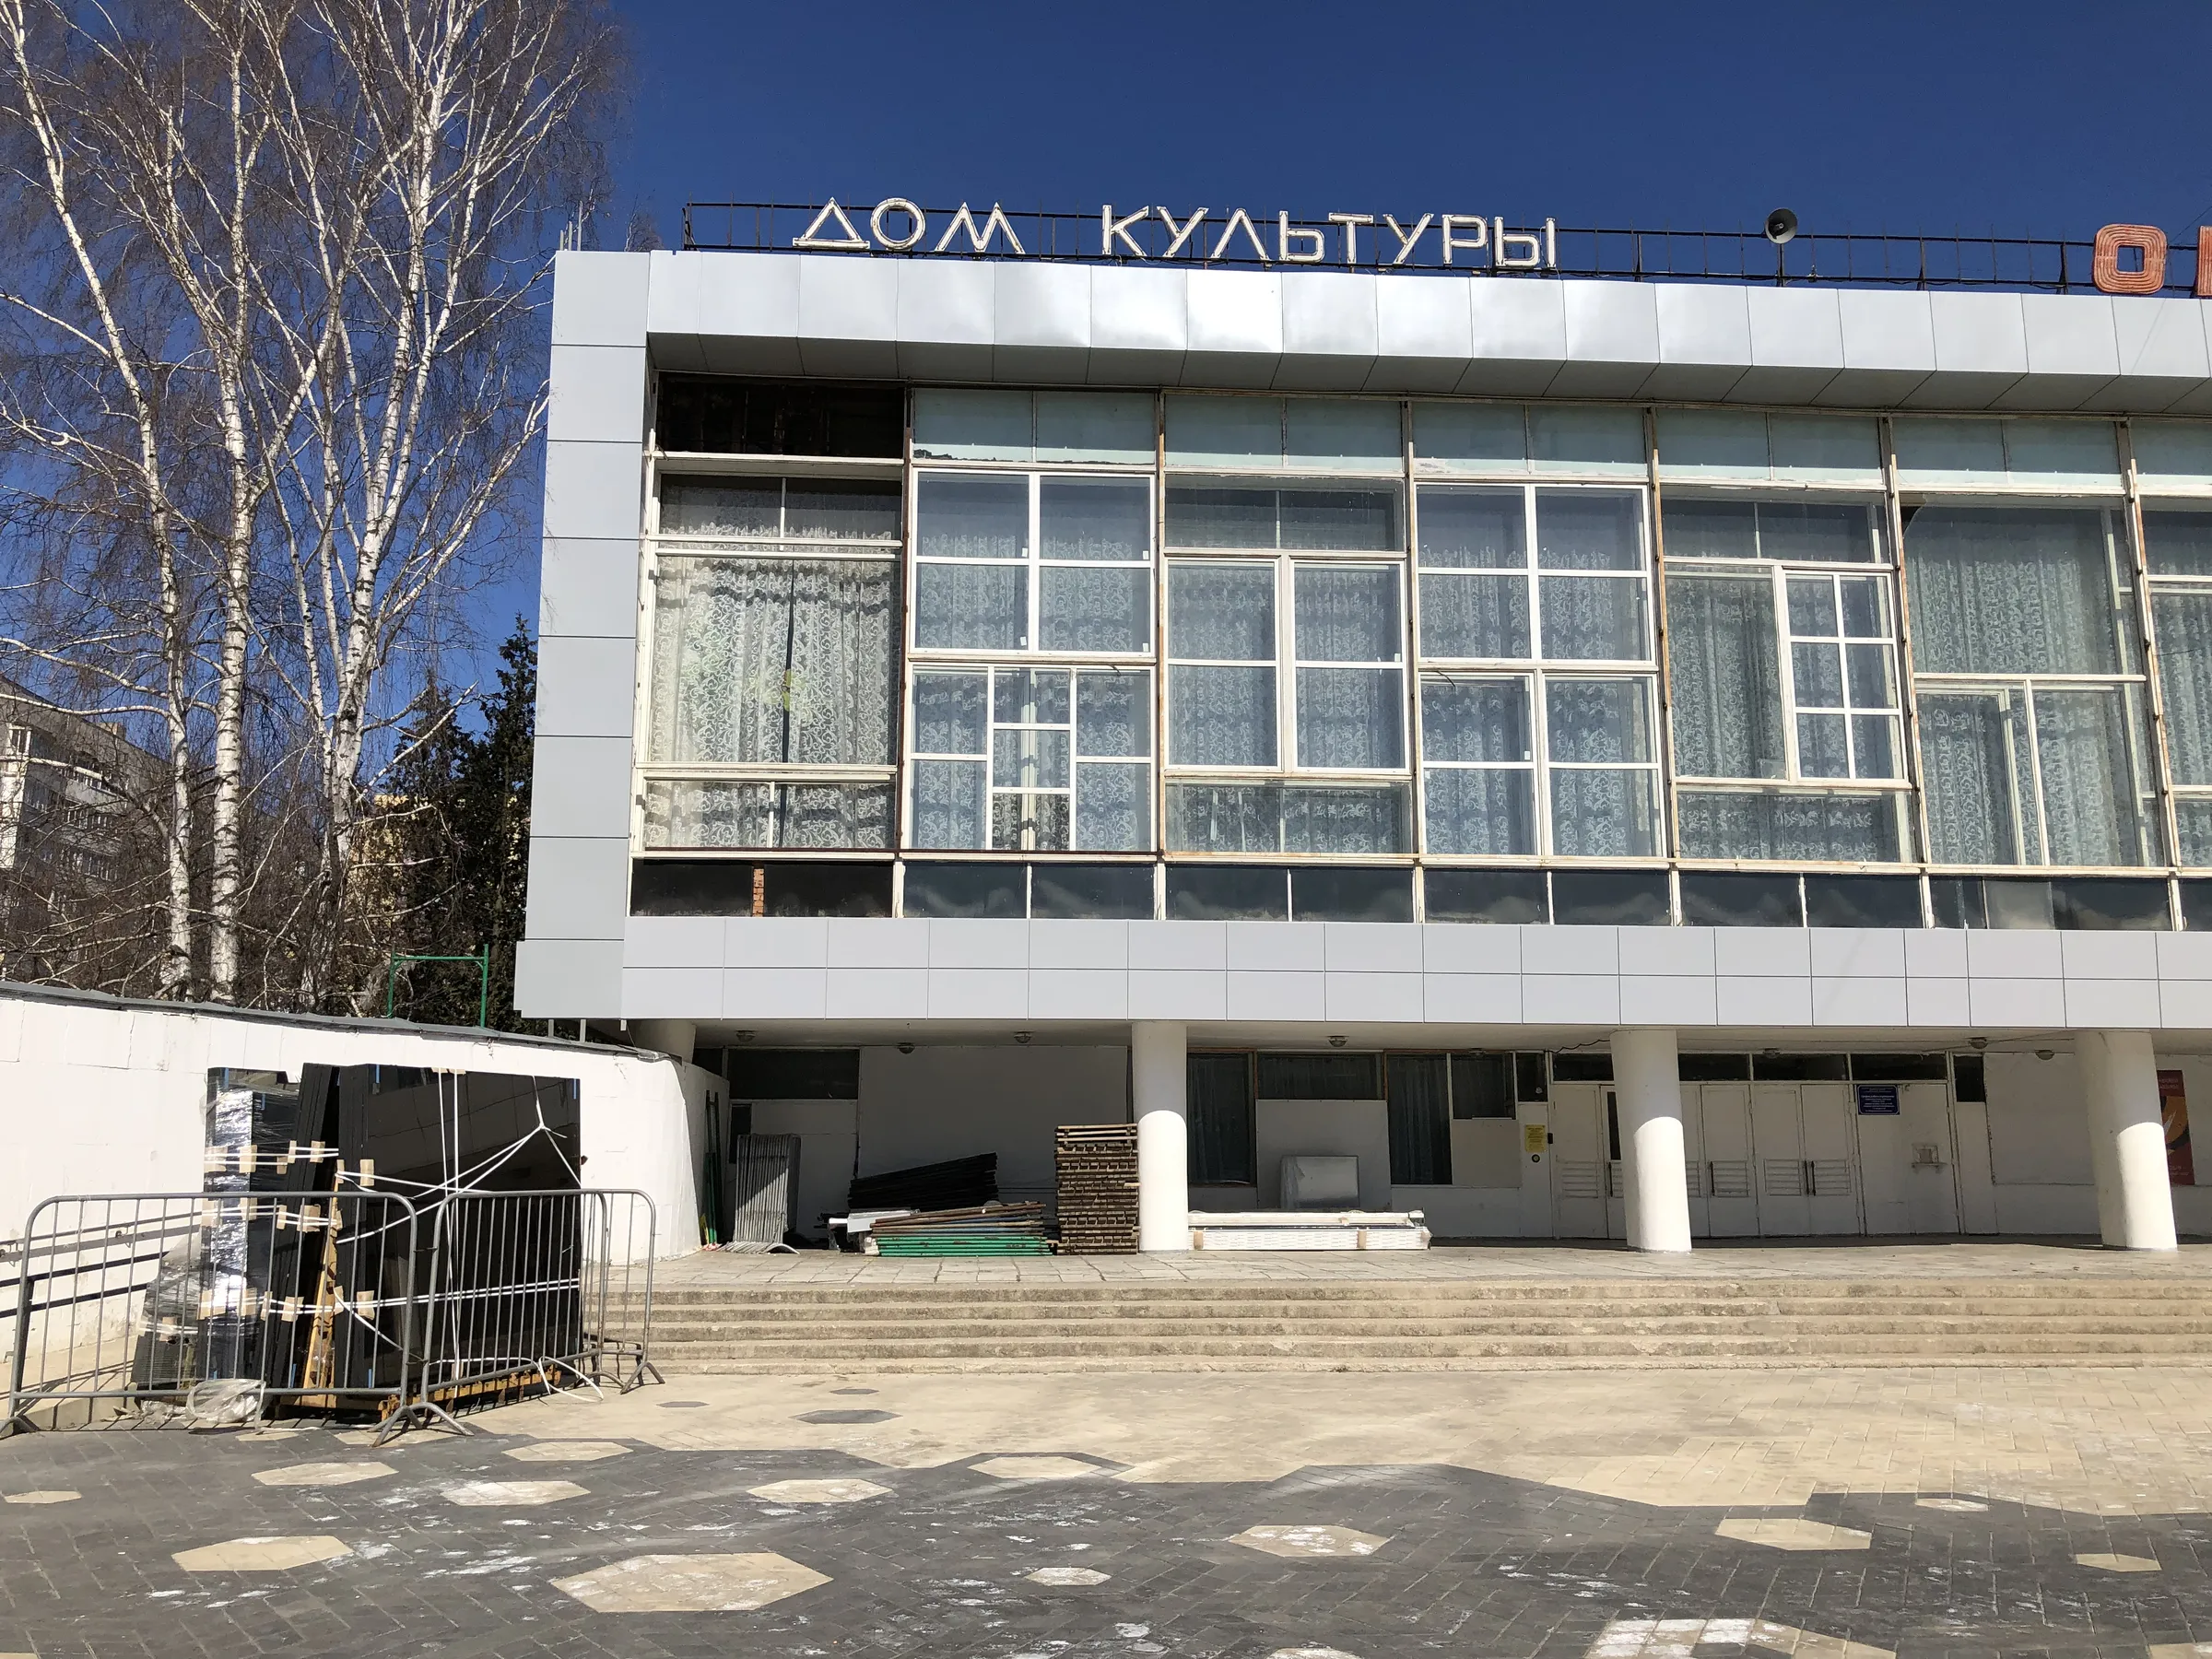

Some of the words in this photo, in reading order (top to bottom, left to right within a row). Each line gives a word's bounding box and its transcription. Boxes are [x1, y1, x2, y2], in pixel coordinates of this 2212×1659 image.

[793, 196, 1026, 255] ДОМ
[1101, 204, 1558, 269] КУЛЬТУРЫ
[2093, 223, 2212, 297] О
